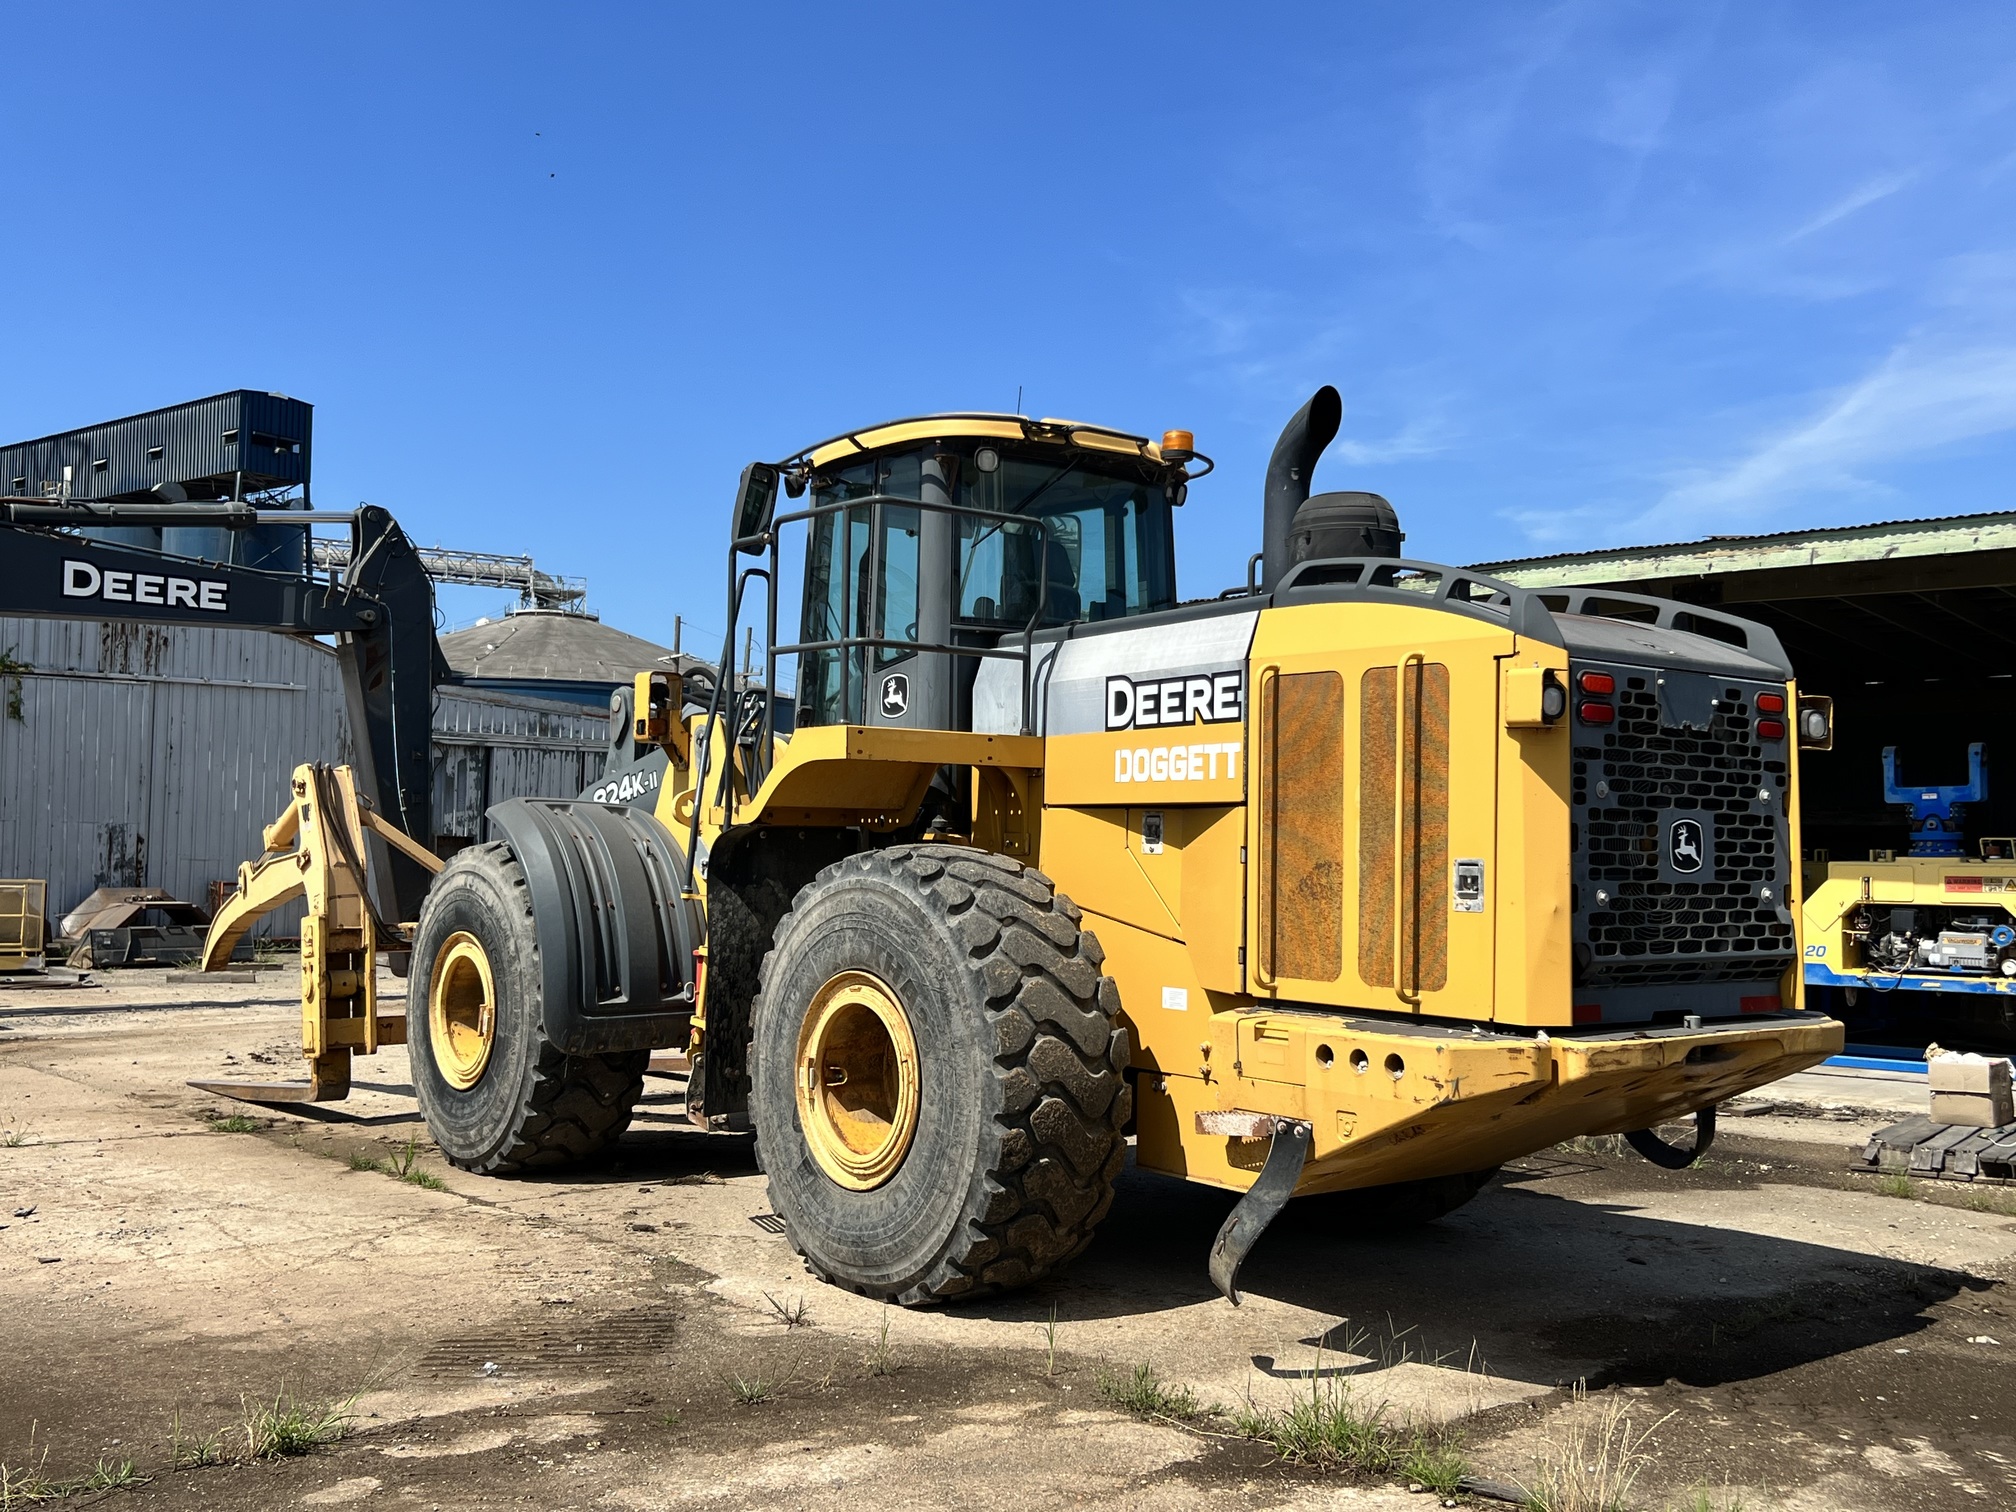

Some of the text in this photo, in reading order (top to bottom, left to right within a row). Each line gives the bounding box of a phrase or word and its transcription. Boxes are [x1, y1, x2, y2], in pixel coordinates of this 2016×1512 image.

[63, 559, 228, 611] DEERE
[1106, 673, 1241, 730] DEERE
[1114, 742, 1241, 783] DOGGETT
[1804, 945, 1827, 957] 20
